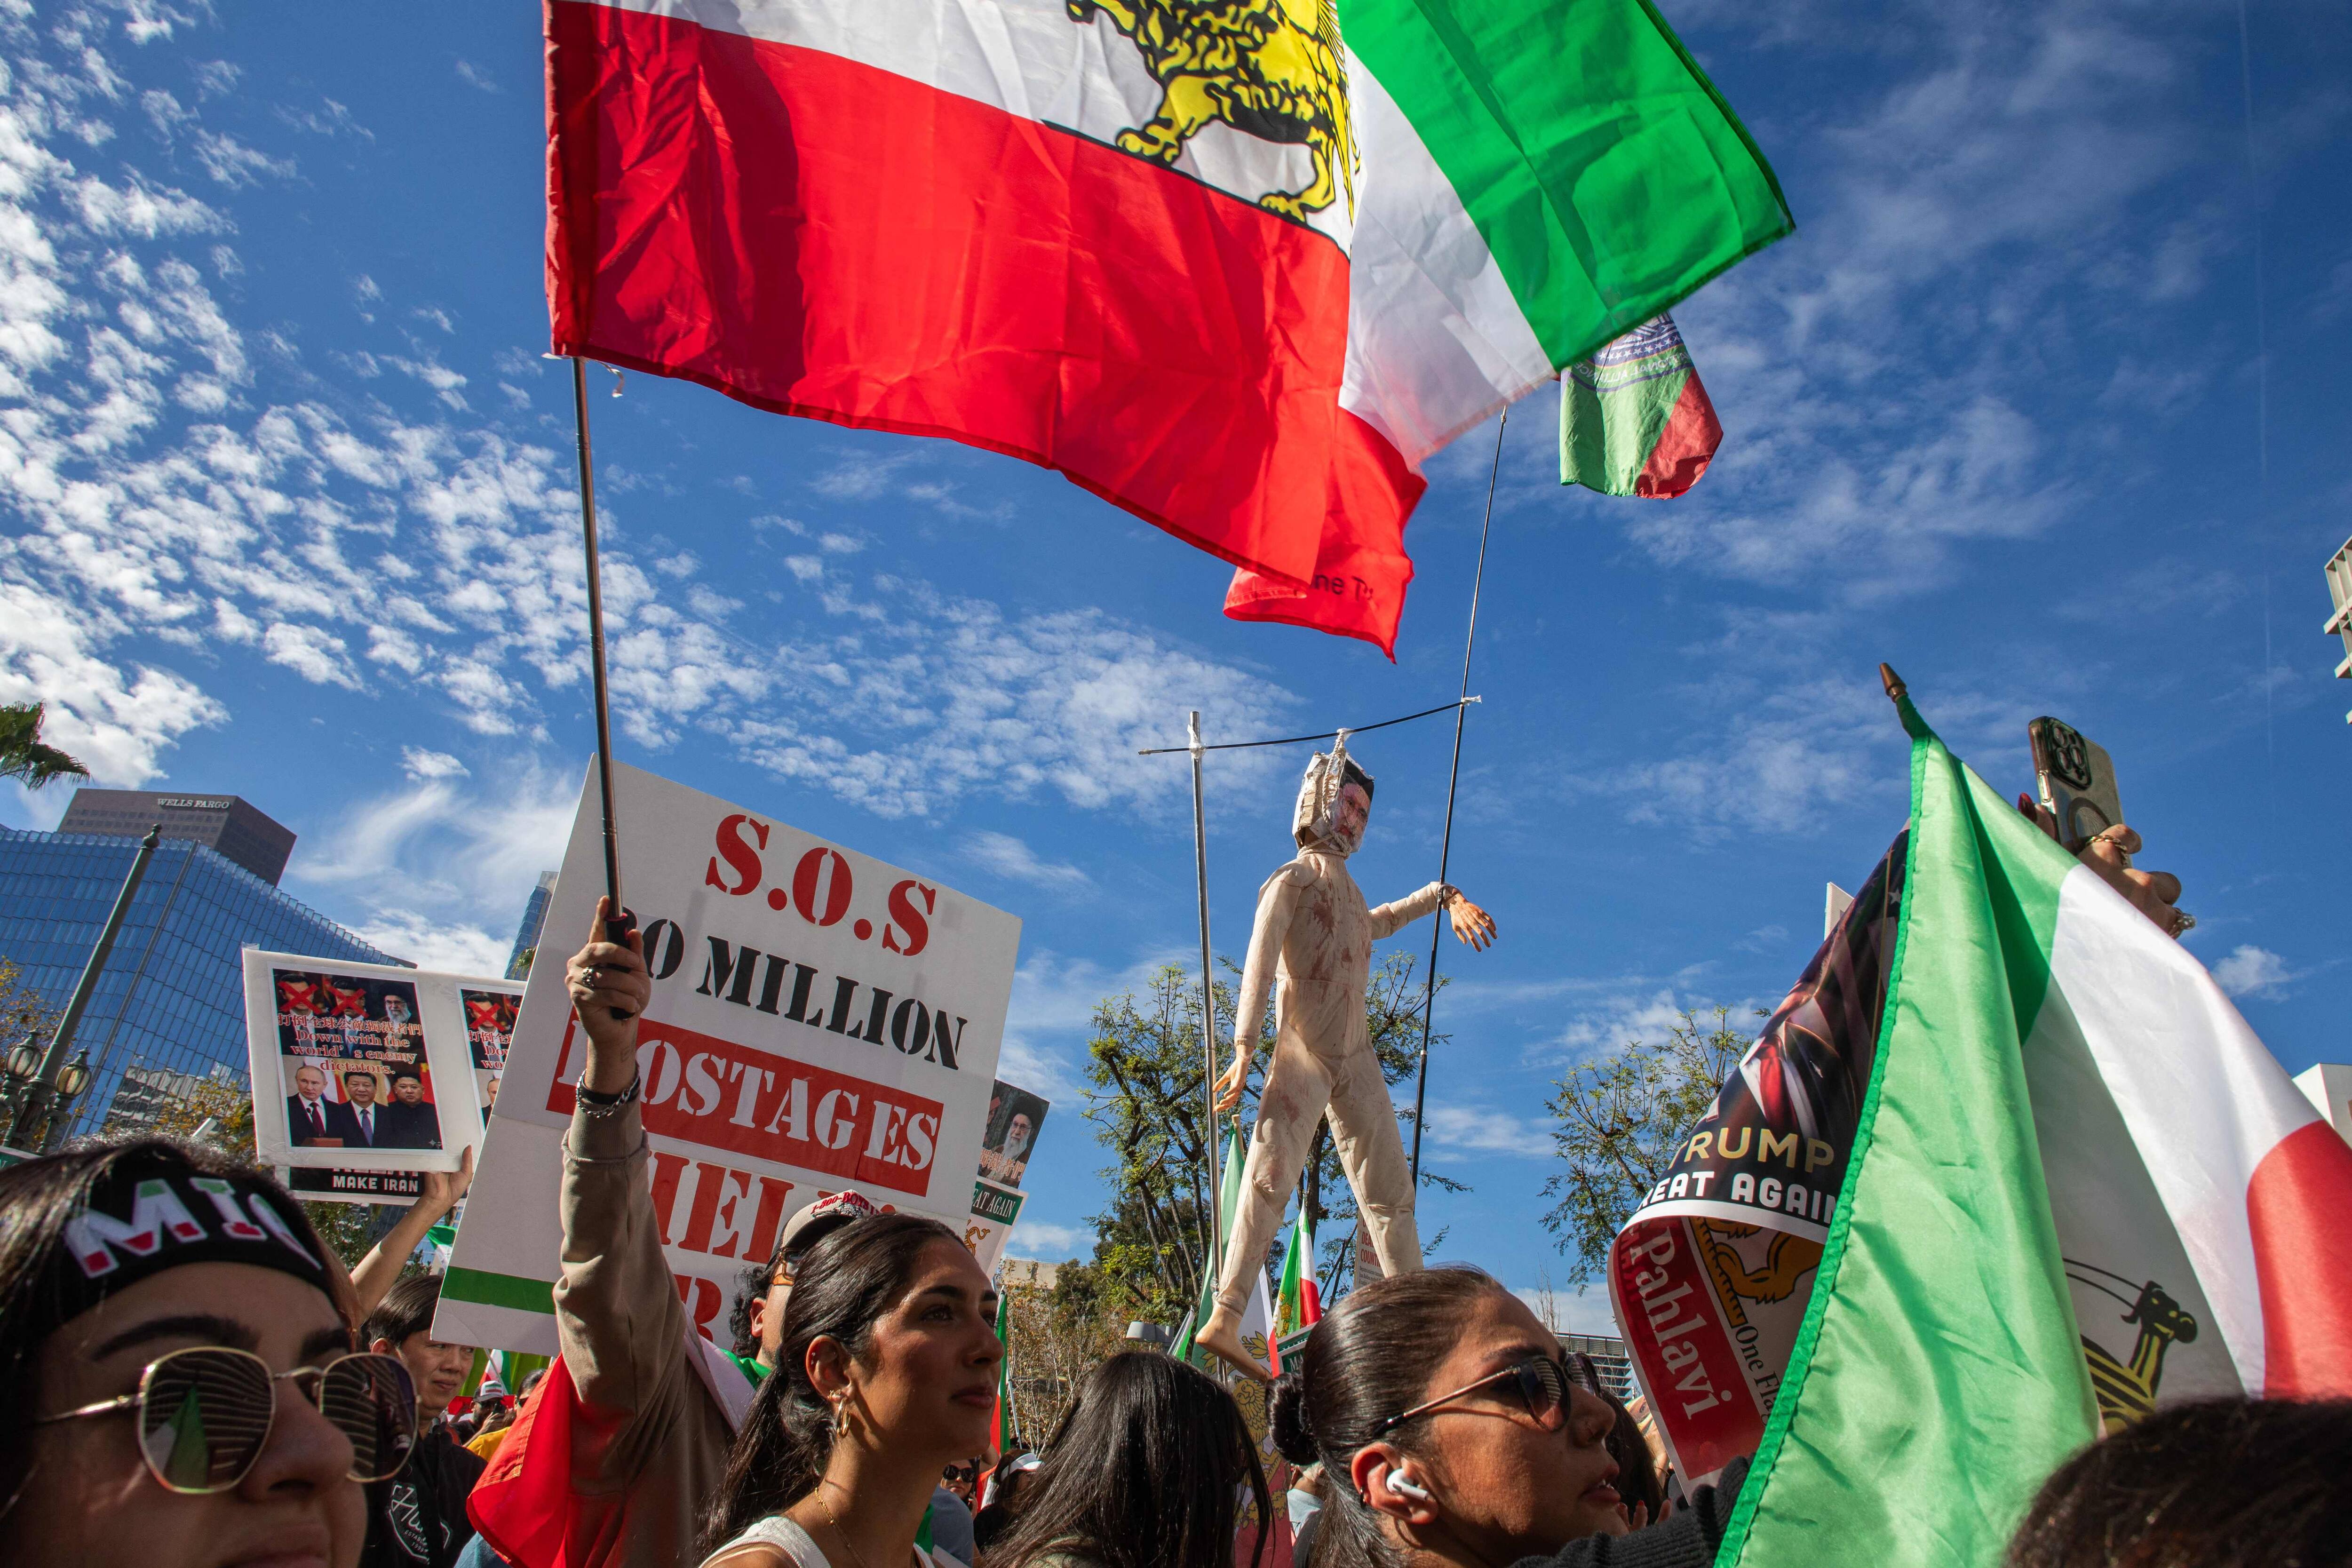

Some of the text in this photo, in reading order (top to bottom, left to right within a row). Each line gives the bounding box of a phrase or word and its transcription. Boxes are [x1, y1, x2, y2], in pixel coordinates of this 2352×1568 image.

[1311, 574, 1344, 595] ne
[158, 798, 229, 809] WELLS FARGO
[705, 813, 936, 956] S.O.S
[620, 906, 968, 1071] 0 MILLION
[296, 1030, 410, 1048] Down with the
[320, 1059, 396, 1075] dictators.
[366, 1051, 418, 1064] enemy
[333, 1176, 419, 1192] MAKE IRAN
[987, 1194, 1016, 1218] AGAIN
[1629, 1226, 1732, 1420] Pahlavi
[1735, 1326, 1764, 1372] One
